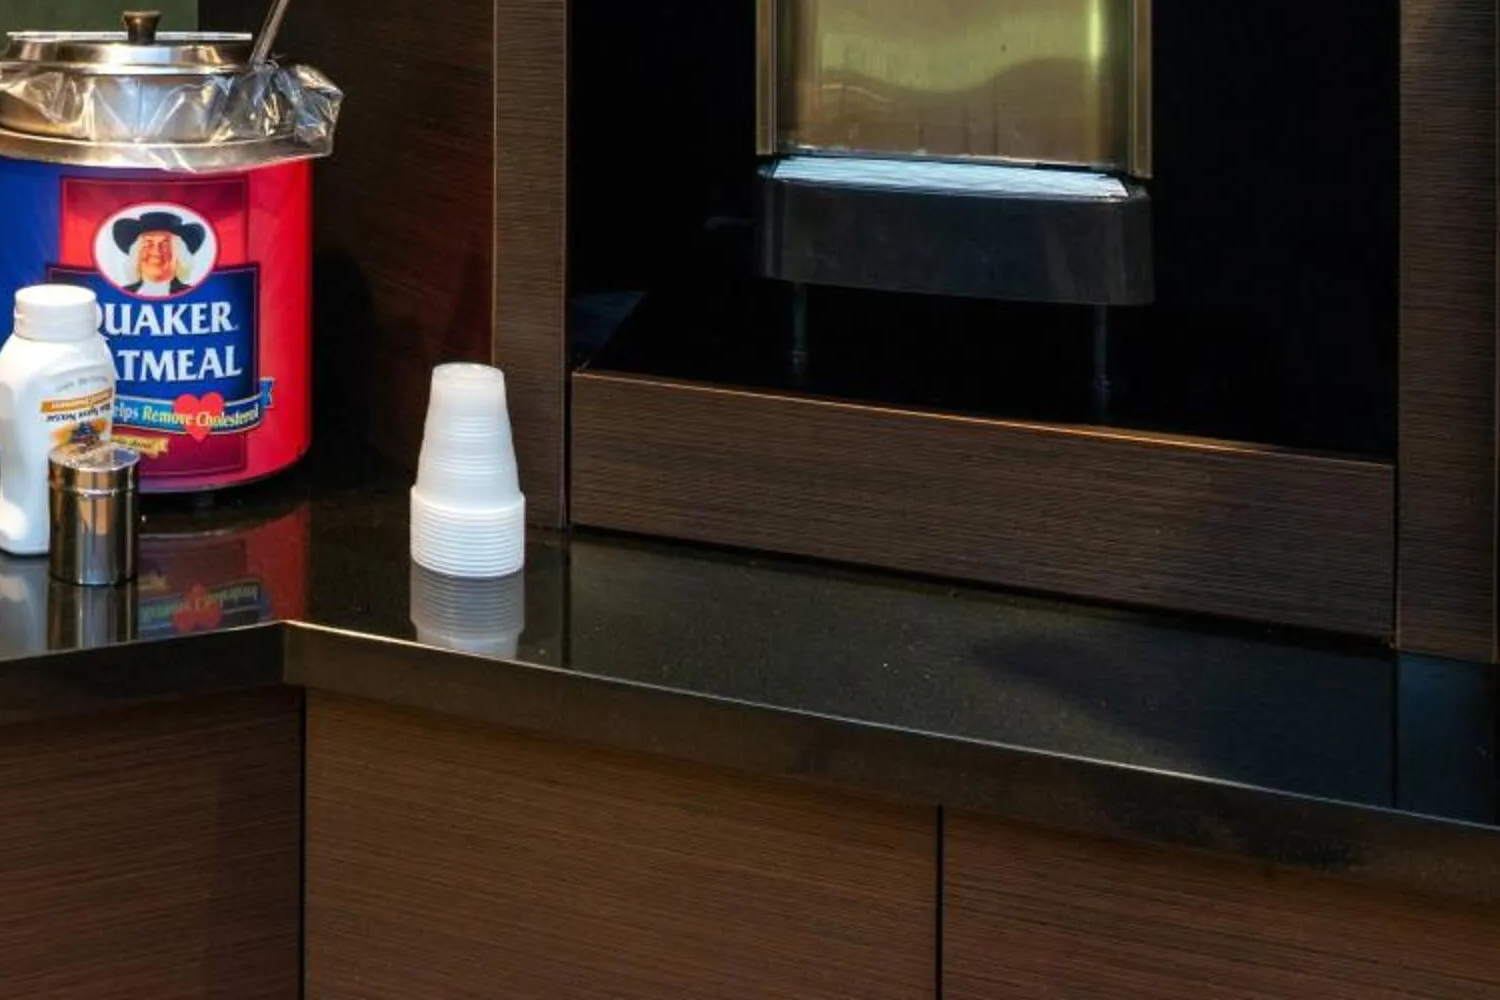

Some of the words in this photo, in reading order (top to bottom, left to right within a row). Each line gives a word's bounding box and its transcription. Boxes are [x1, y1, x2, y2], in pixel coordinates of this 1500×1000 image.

[96, 301, 235, 337] UAKER
[142, 405, 194, 425] Remove
[195, 403, 260, 428] Cholesterol
